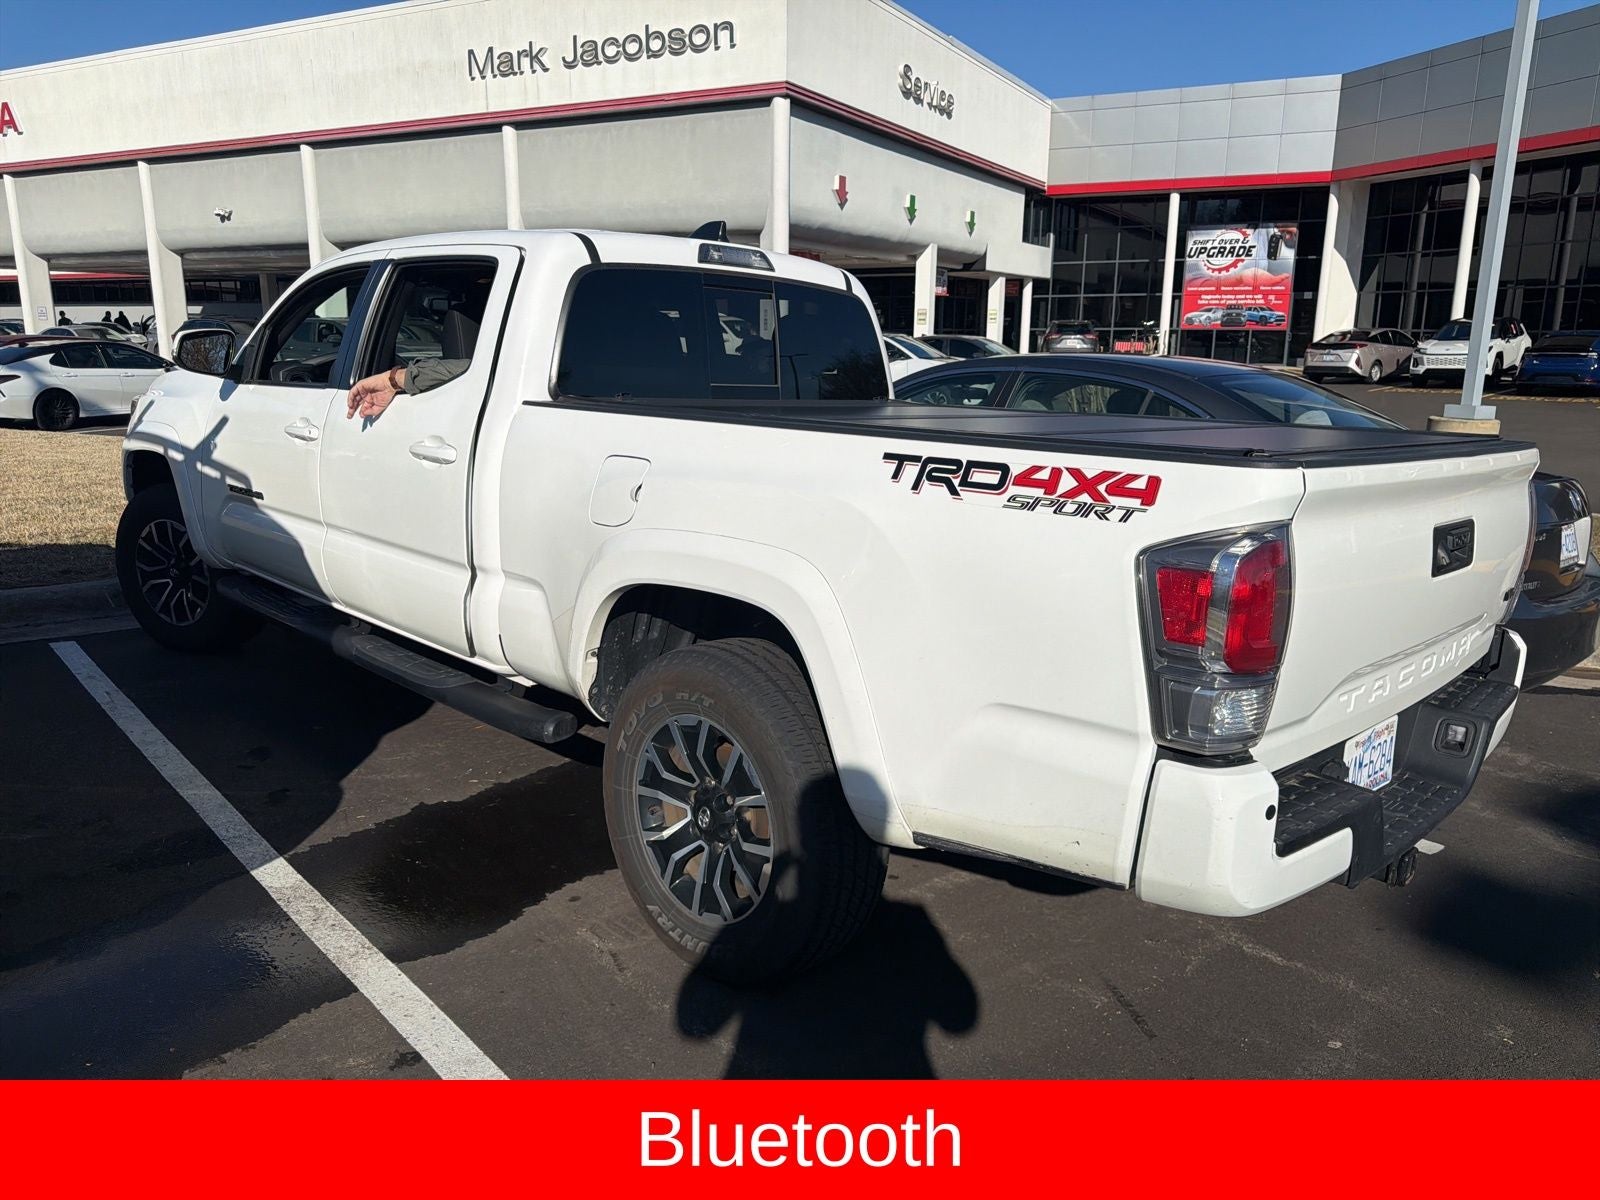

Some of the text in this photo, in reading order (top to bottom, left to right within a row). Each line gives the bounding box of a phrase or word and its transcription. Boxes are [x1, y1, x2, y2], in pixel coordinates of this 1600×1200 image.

[467, 20, 736, 80] Mark Jacobson
[901, 64, 954, 117] Service
[1187, 245, 1256, 258] UPGRADE
[1241, 236, 1250, 244] &
[882, 452, 1012, 500] TRD
[1003, 494, 1148, 524] SPORT
[1338, 634, 1476, 712] TACOMA
[616, 692, 664, 752] TOYO
